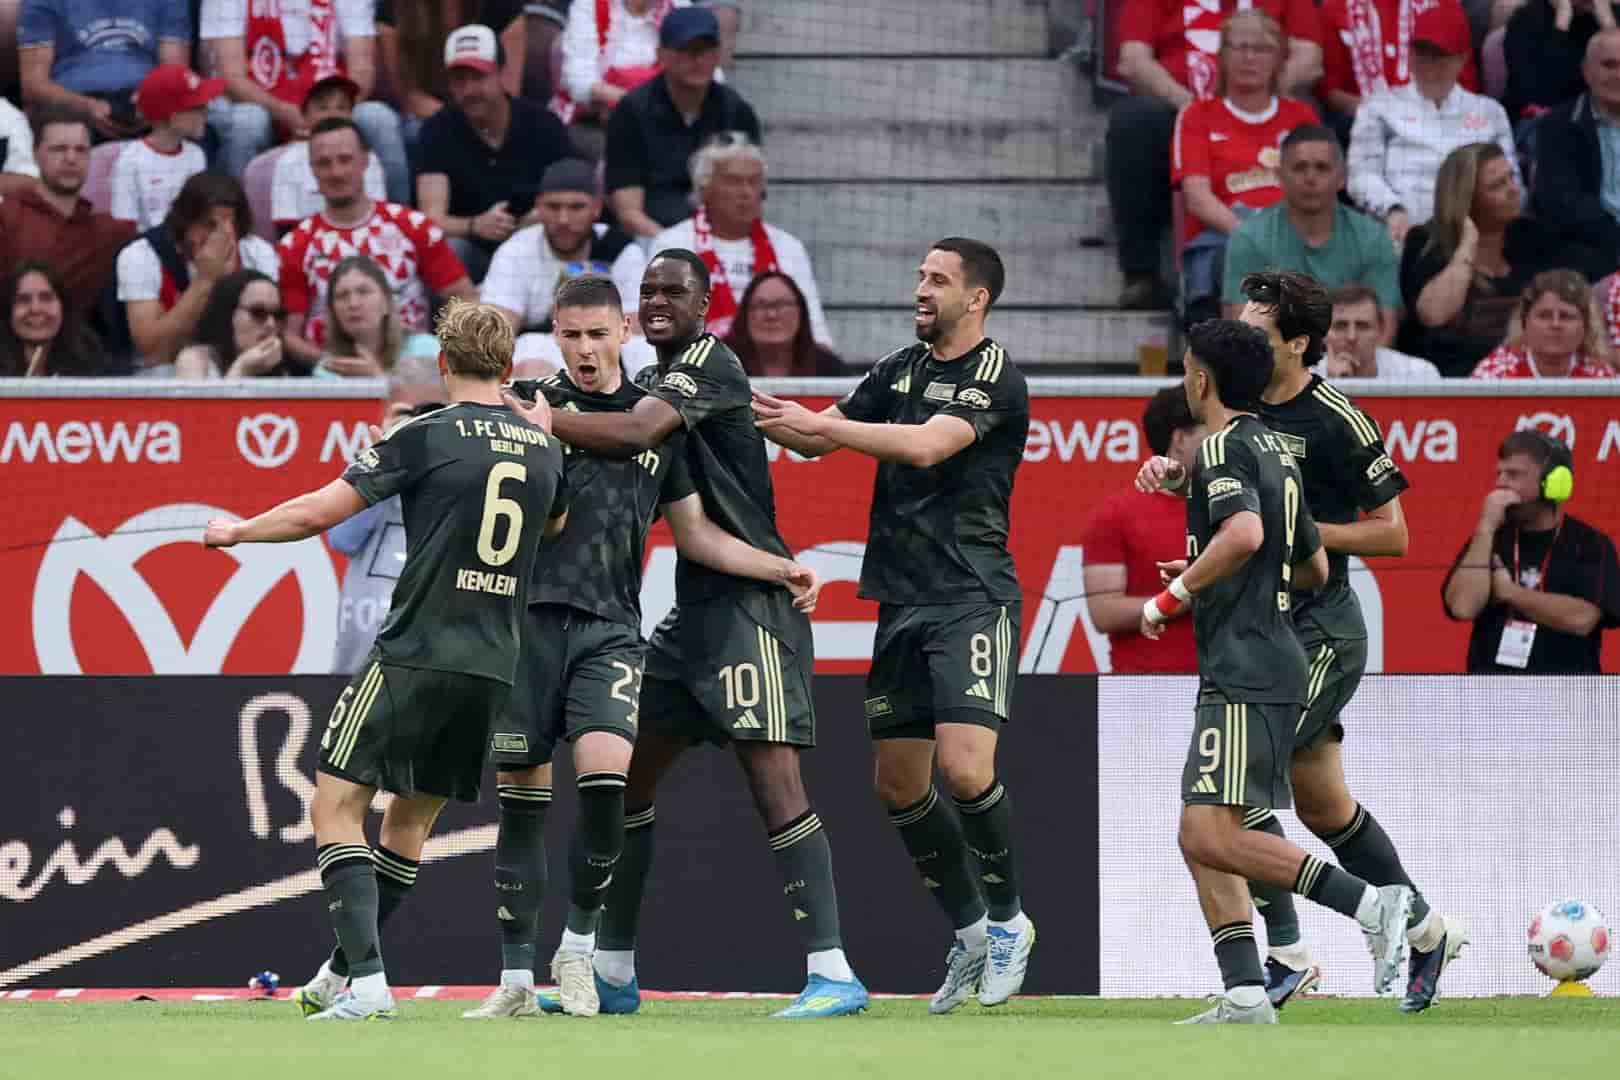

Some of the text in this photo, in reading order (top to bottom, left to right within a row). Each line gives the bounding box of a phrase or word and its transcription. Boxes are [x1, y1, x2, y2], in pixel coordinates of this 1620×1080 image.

[455, 419, 549, 448] 1. FC UNION
[1021, 418, 1140, 463] ewa
[1382, 418, 1458, 463] wa
[477, 461, 528, 567] 6
[456, 568, 518, 597] KEMLEIN
[339, 597, 392, 634] FO
[969, 632, 992, 678] 8
[327, 685, 355, 730] 6
[718, 661, 761, 710] 10
[1198, 726, 1222, 774] 9
